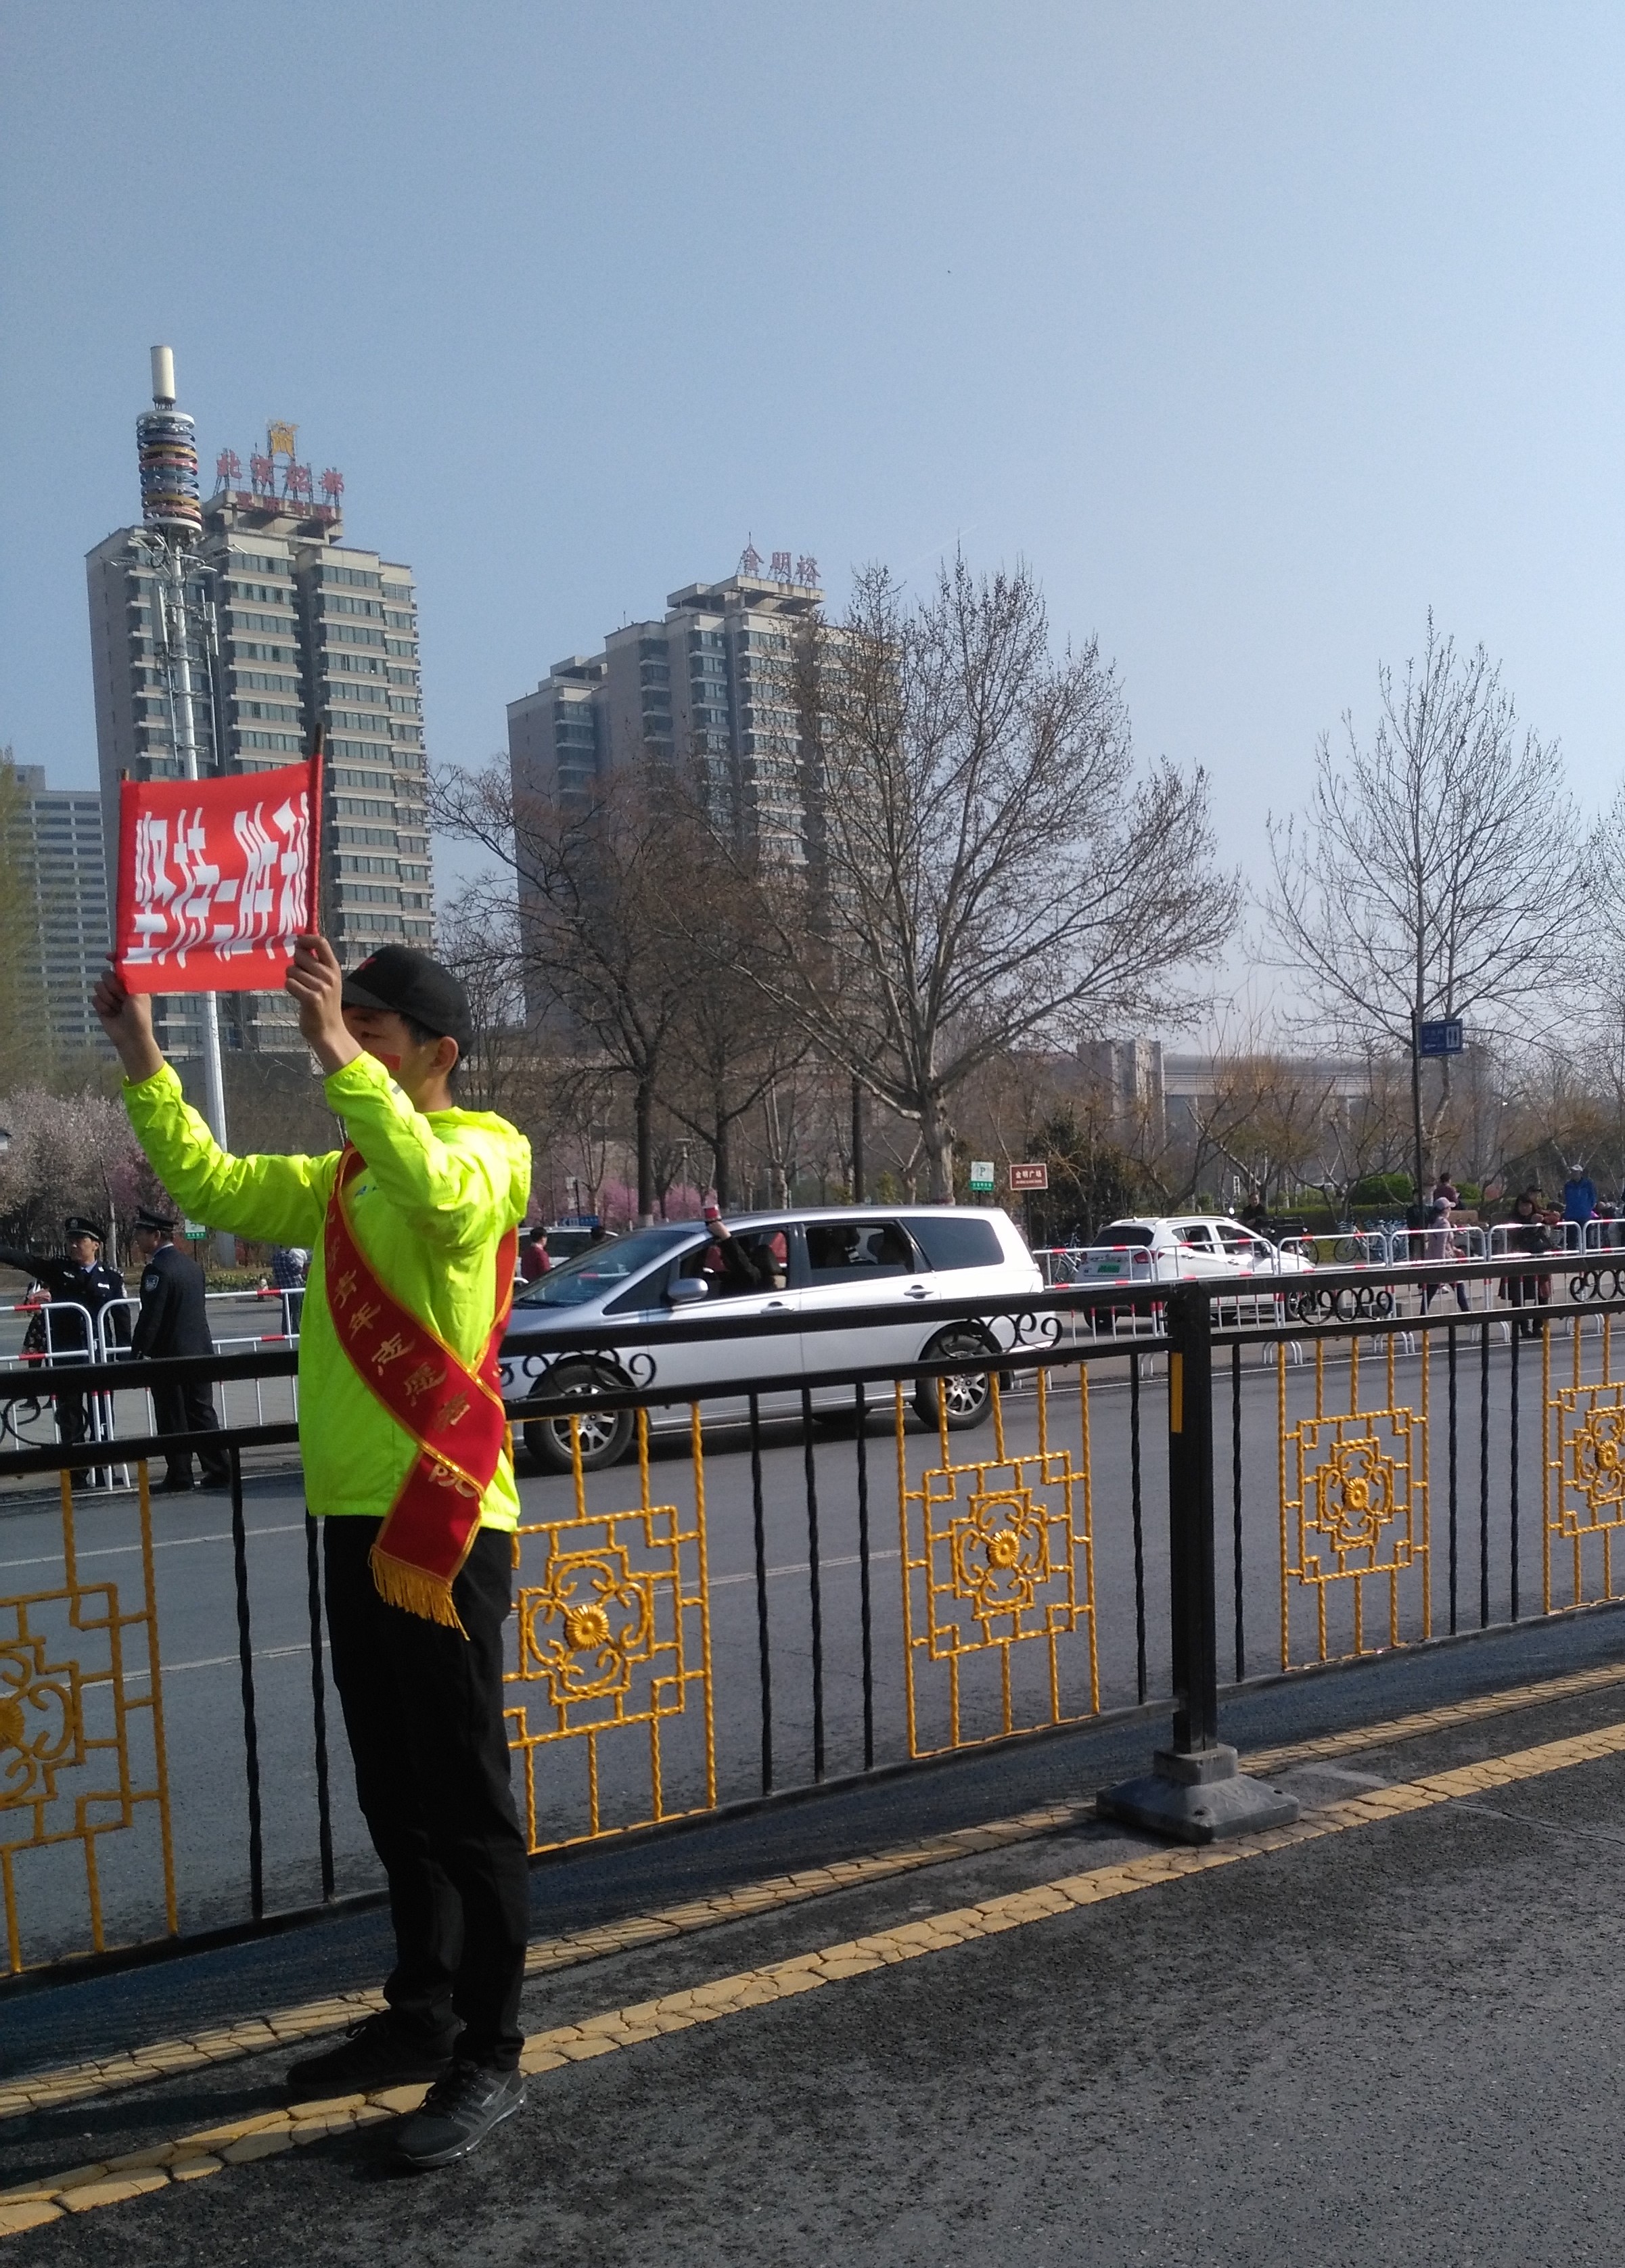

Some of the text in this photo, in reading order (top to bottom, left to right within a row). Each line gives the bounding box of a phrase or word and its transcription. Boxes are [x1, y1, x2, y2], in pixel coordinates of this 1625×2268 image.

[979, 1167, 986, 1177] P
[1015, 1170, 1042, 1179] 金明广场
